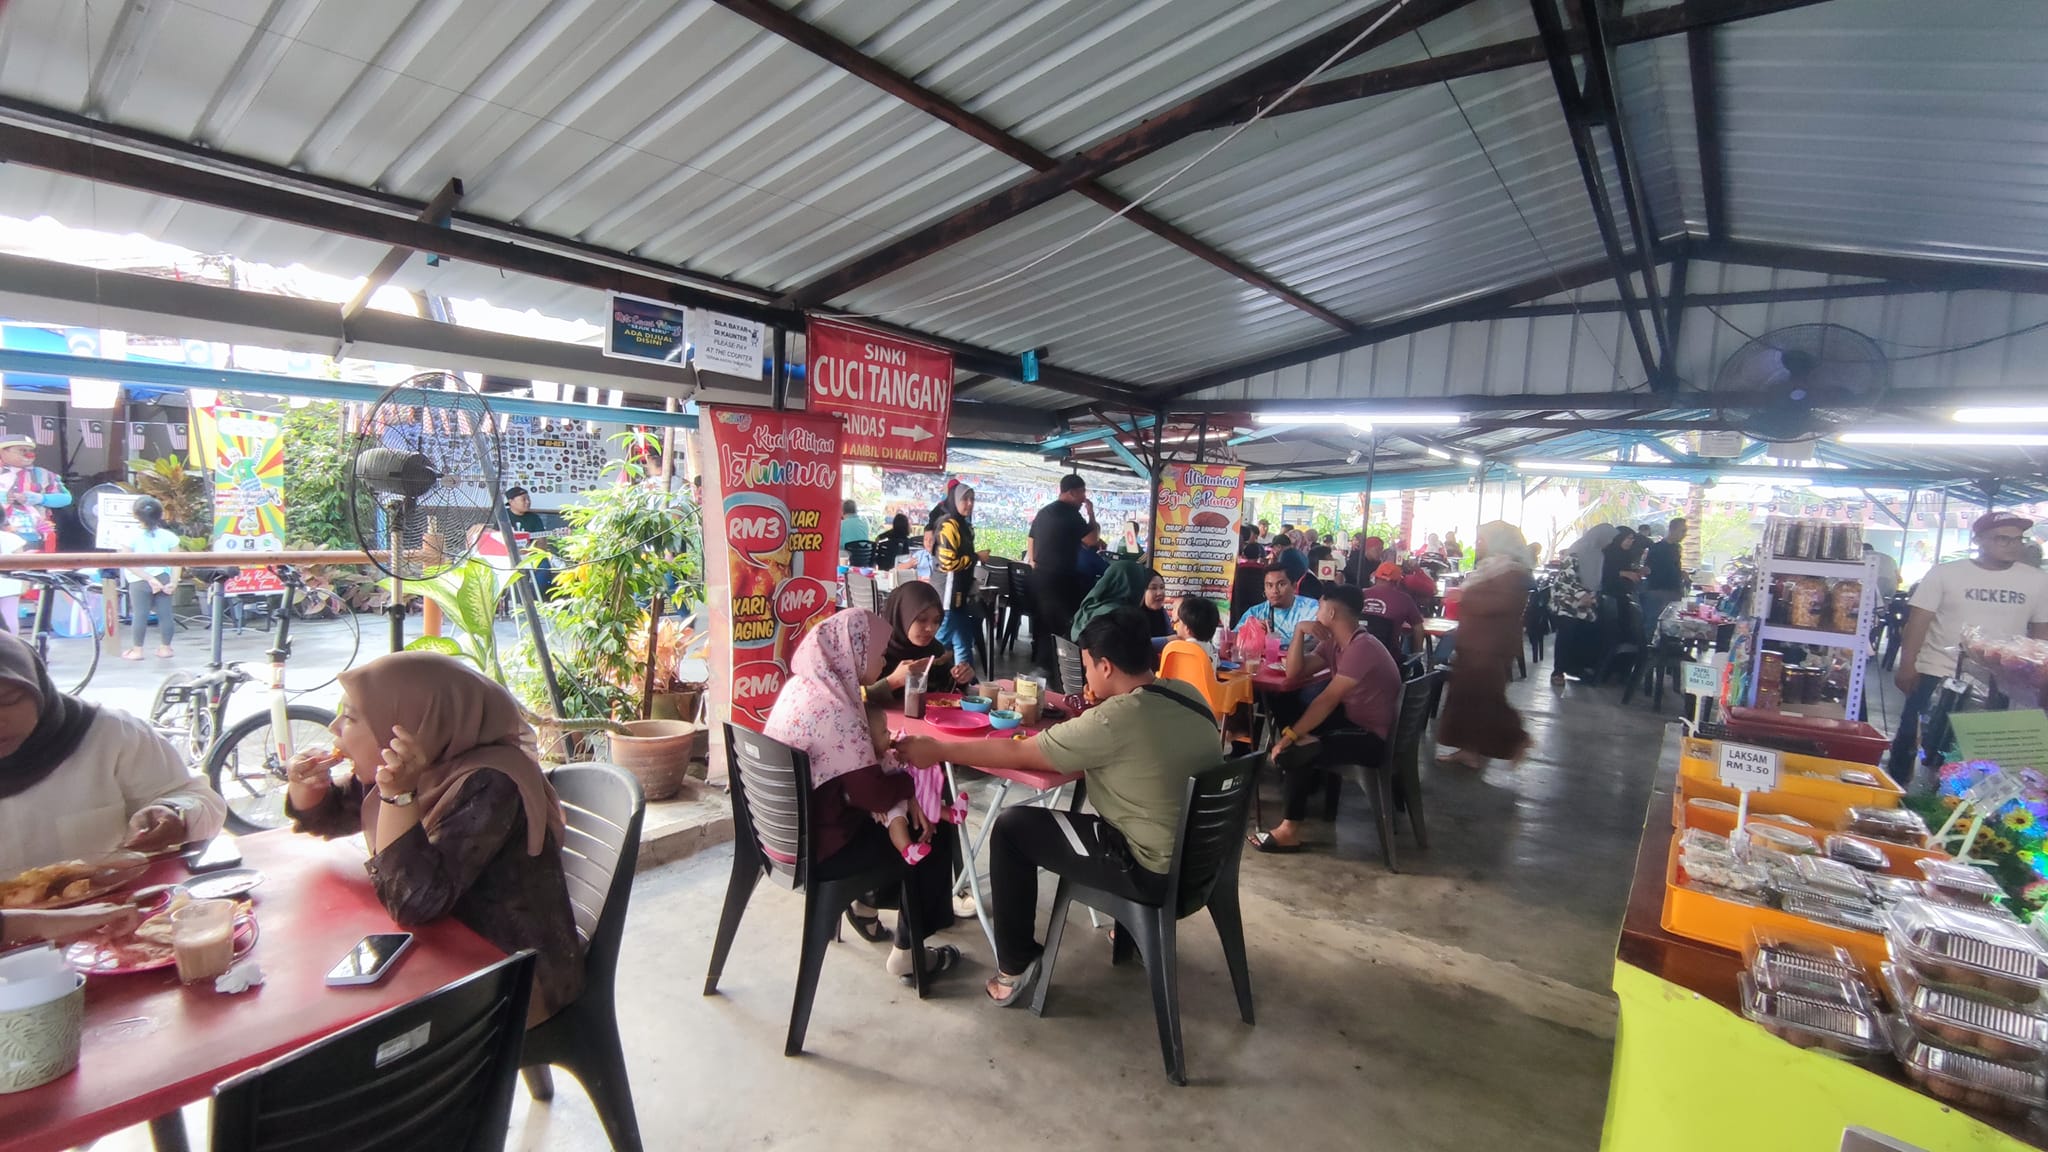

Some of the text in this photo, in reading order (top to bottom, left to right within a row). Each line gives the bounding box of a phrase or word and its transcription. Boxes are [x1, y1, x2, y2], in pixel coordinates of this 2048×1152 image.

[624, 329, 673, 343] ADA DIJUAL
[636, 337, 662, 346] DISINI
[727, 351, 753, 361] COUNTER
[864, 343, 906, 367] SINKI
[813, 355, 947, 414] CUCI TANGAN
[850, 442, 880, 458] AMBIL
[882, 446, 894, 458] DI
[895, 449, 938, 463] KAUNTER
[722, 443, 837, 489] Istimewa
[1185, 467, 1239, 488] Minuman
[1159, 488, 1192, 511] Sejuk
[1201, 490, 1237, 508] Panas
[729, 517, 781, 540] RM3
[790, 510, 820, 529] KARI
[788, 533, 823, 551] CEKER
[732, 596, 766, 617] KARI
[780, 588, 816, 613] RM4
[1965, 588, 2026, 605] KICKERS
[733, 619, 775, 641] AGING
[733, 671, 779, 699] RM6
[1729, 749, 1767, 764] LAKSAM
[1726, 760, 1769, 775] RM 3.50
